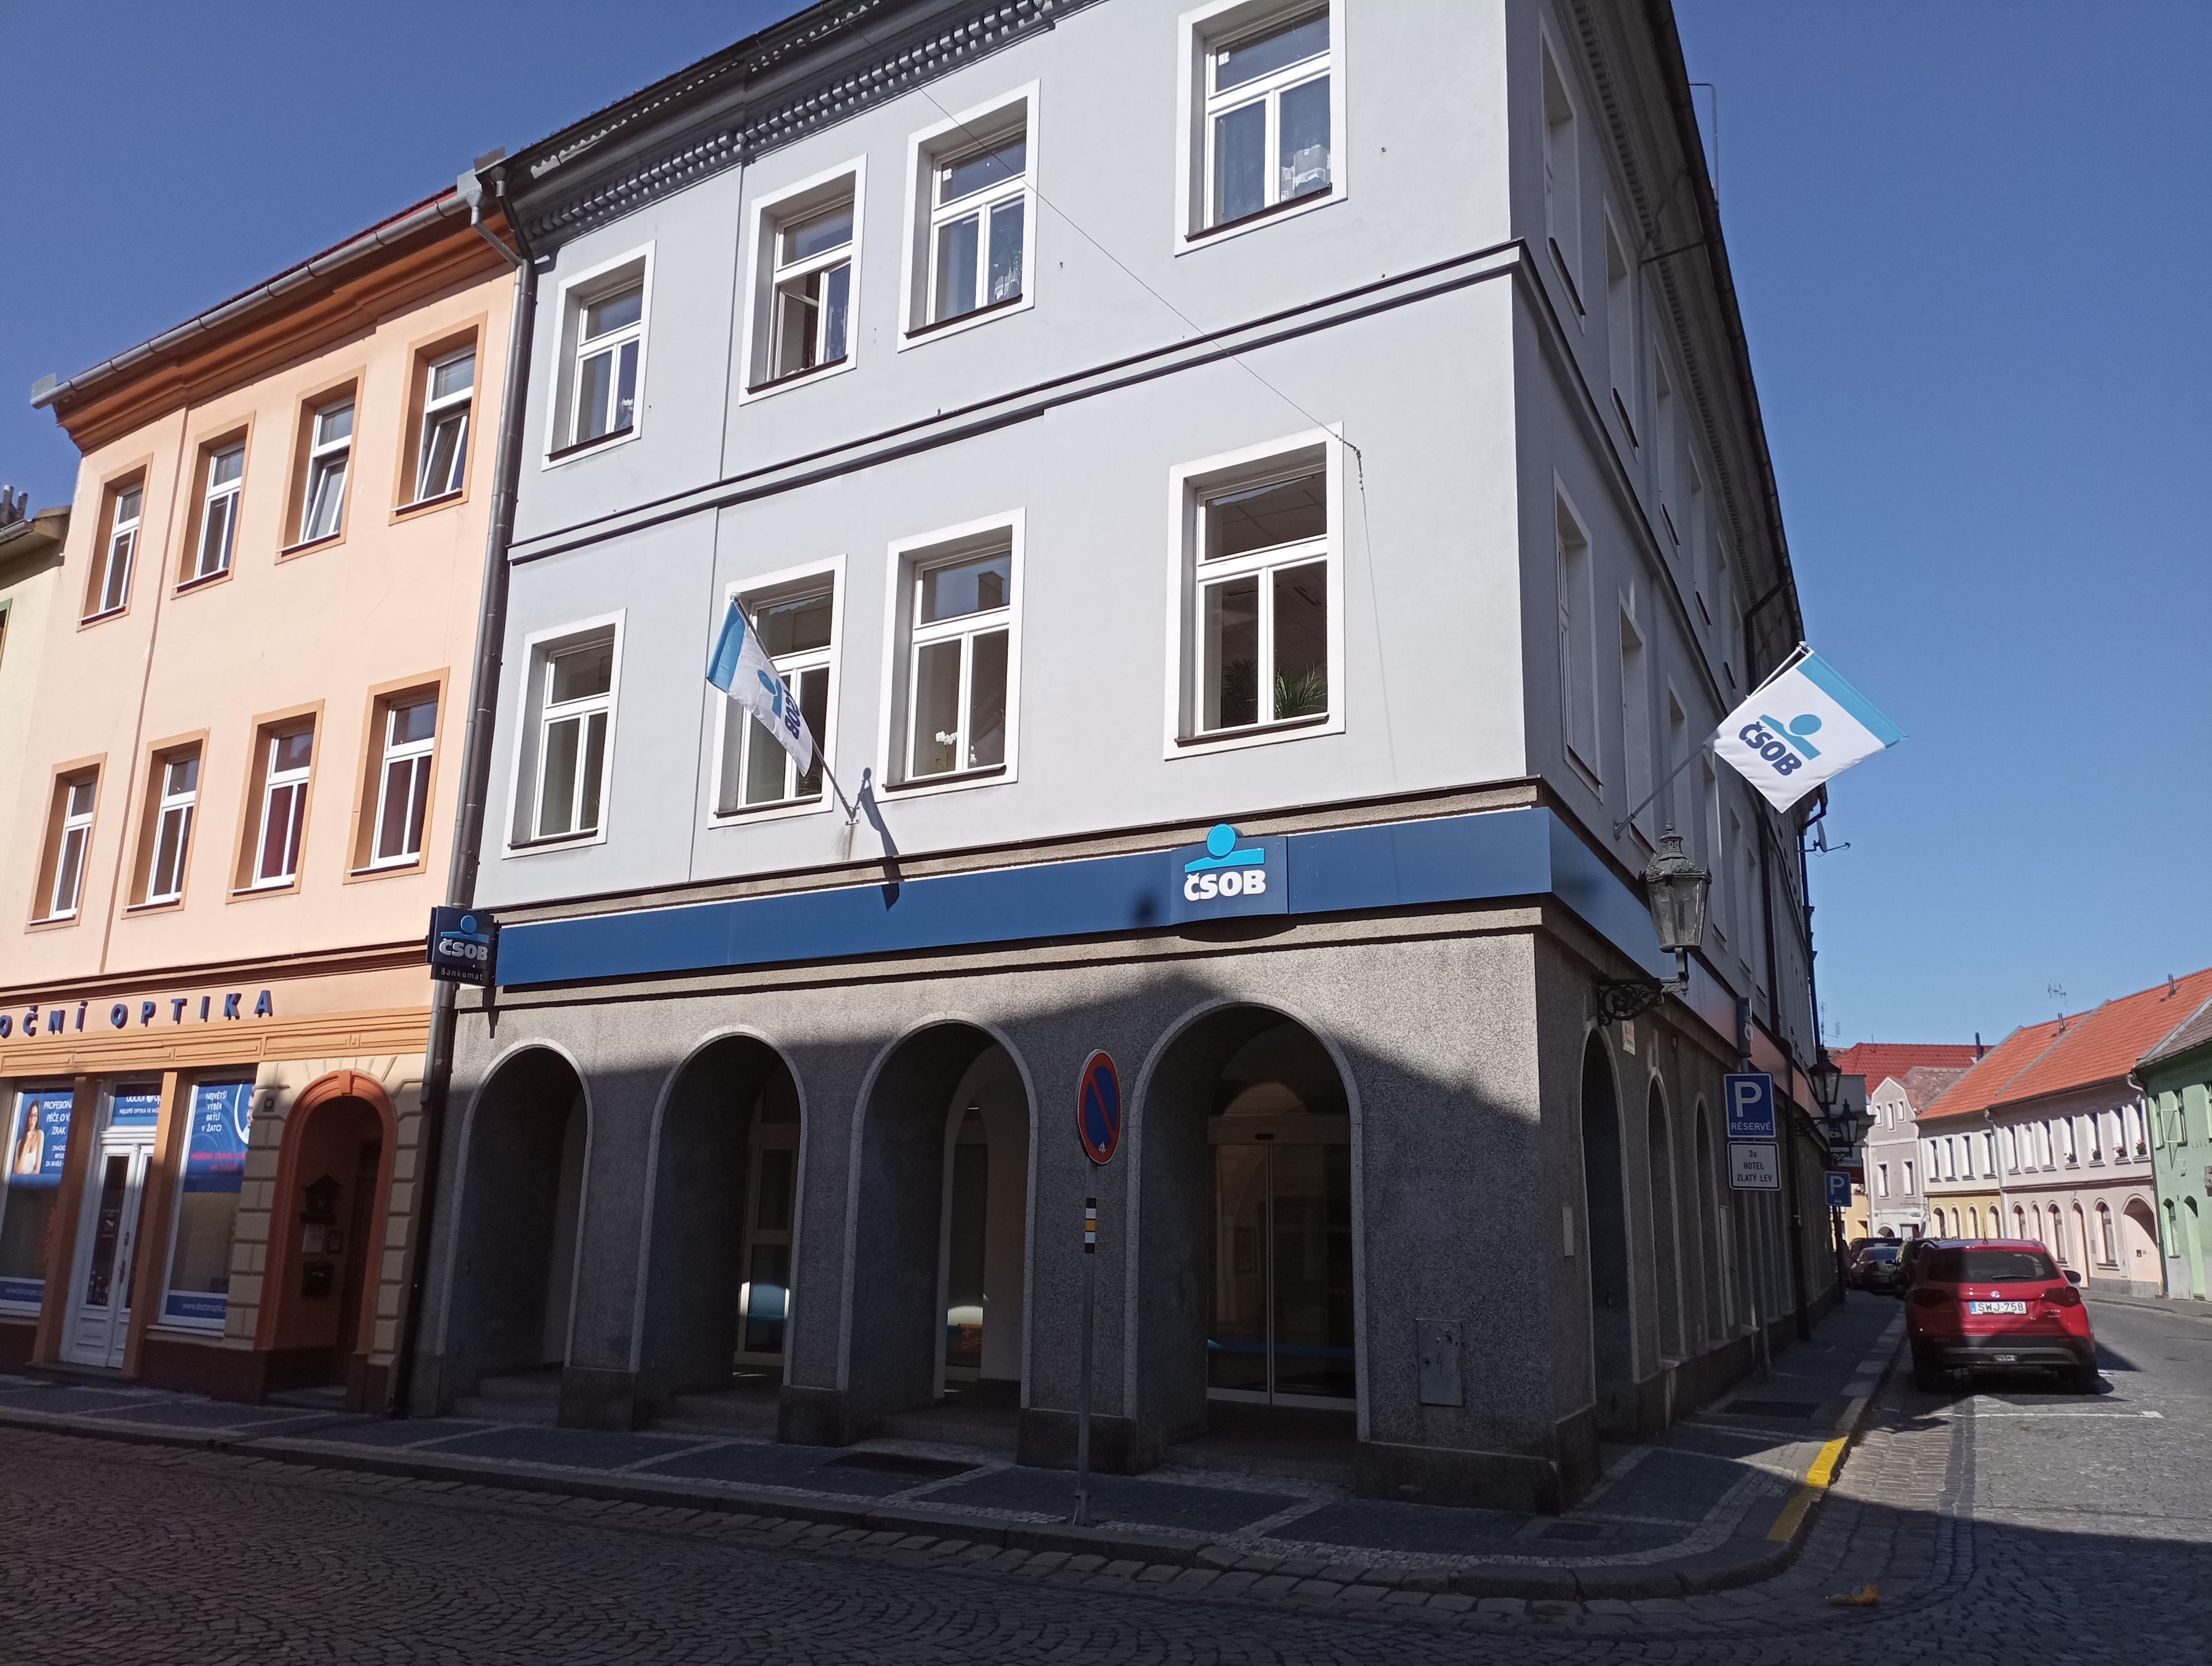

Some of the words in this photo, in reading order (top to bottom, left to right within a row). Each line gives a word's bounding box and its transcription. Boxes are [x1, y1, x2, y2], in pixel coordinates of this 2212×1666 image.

[1739, 721, 1802, 776] ČSOB
[1184, 869, 1266, 901] ČSOB
[439, 938, 488, 961] ČSOB
[441, 967, 483, 980] Bankomat
[0, 1001, 88, 1038] OČNÍ
[110, 990, 273, 1028] OPTIKA
[205, 1090, 228, 1101] NEJVĚTŠÍ
[1735, 1081, 1762, 1117] P
[43, 1100, 73, 1109] PROFESION
[207, 1101, 222, 1110] VÝBĚR
[47, 1112, 59, 1122] PÉČE
[60, 1113, 66, 1122] O
[66, 1113, 71, 1122] V
[206, 1111, 221, 1121] BRÝLÍ
[52, 1126, 66, 1135] ZRAK
[206, 1123, 222, 1132] ŽATCI
[1731, 1121, 1771, 1131] RÉSERVÉ
[1737, 1172, 1757, 1182] ZLATÝ
[1830, 1176, 1844, 1195] P
[1978, 1303, 2024, 1311] SWJ-758
